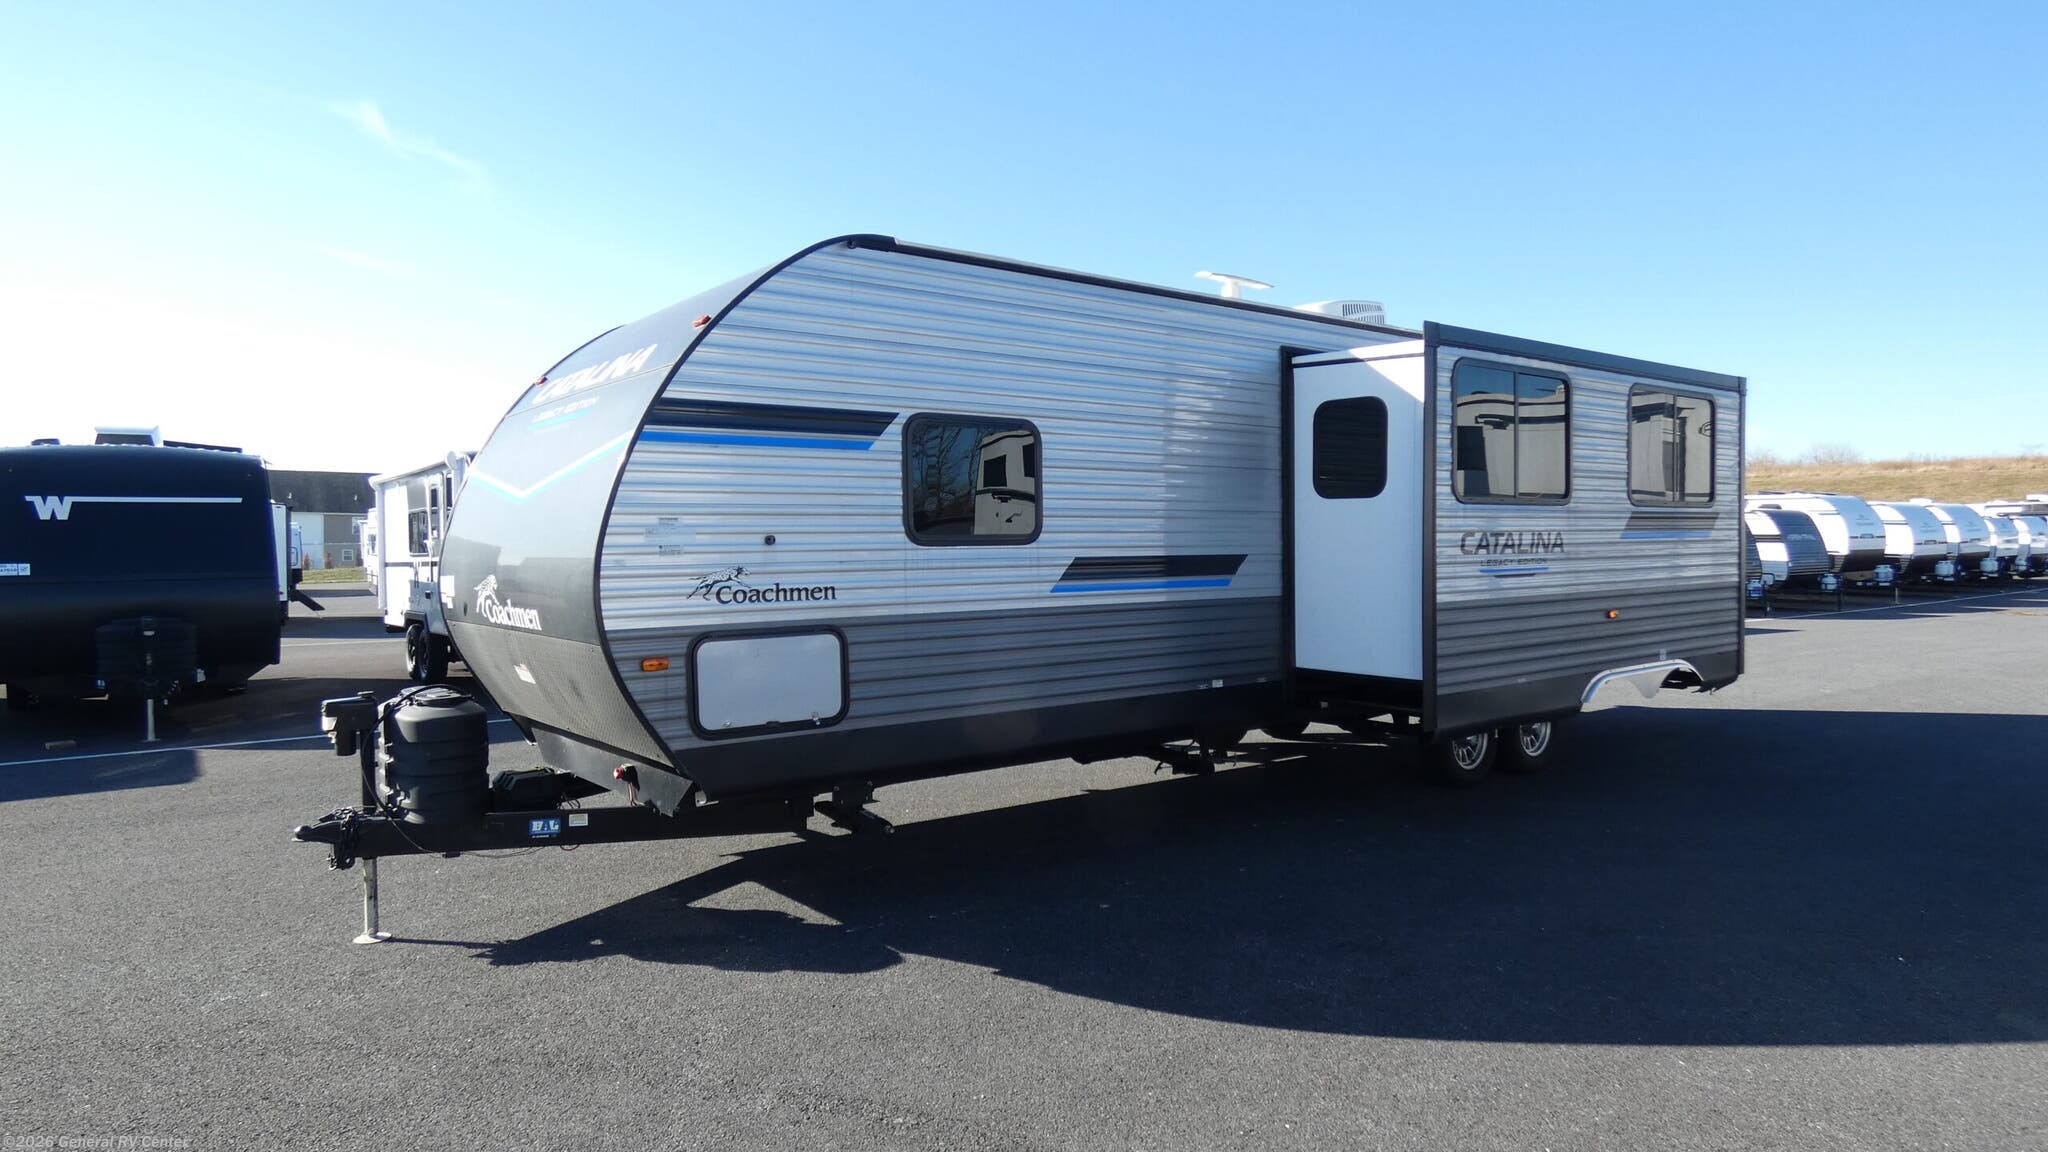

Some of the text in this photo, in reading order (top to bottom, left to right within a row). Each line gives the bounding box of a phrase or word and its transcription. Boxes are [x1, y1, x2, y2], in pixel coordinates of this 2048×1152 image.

[1460, 531, 1565, 555] CATALINA
[715, 583, 837, 605] Coachmen
[485, 598, 542, 631] Coachmen
